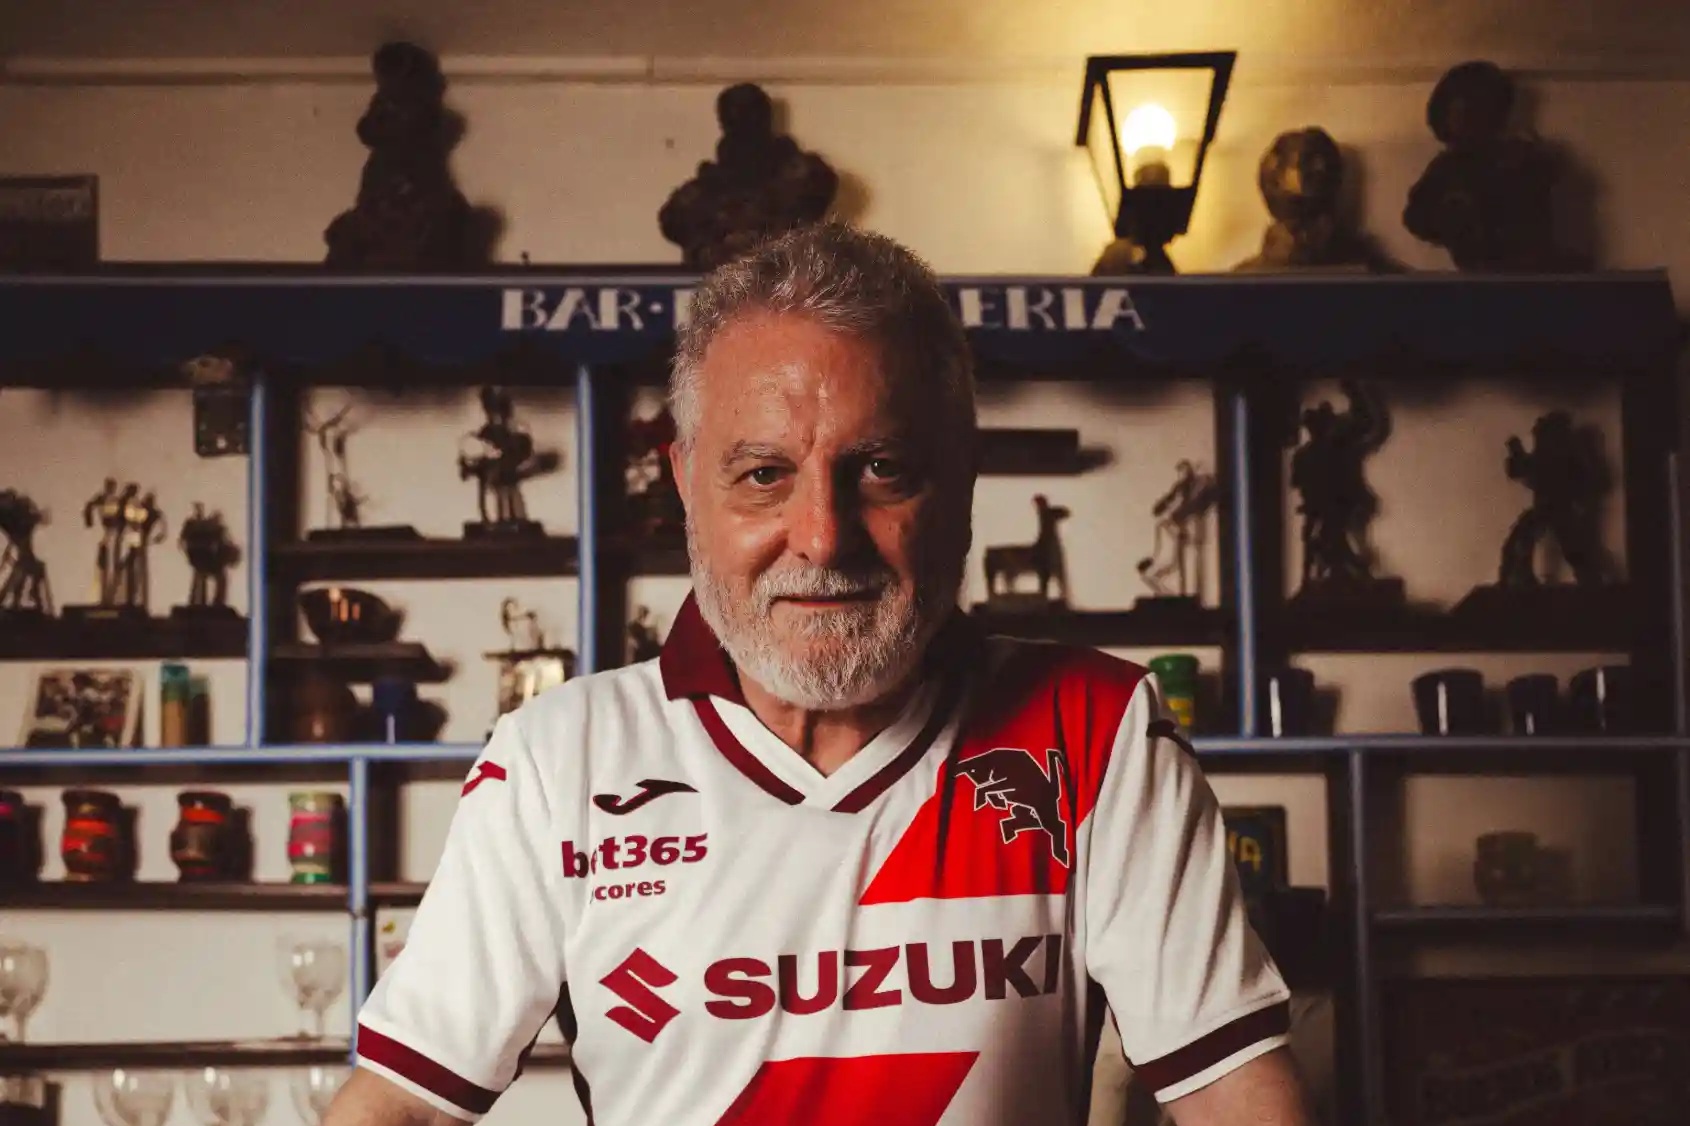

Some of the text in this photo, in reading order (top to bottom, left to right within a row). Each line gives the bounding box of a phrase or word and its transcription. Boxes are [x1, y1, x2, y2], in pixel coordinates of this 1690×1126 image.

[561, 832, 709, 878] bt365
[590, 879, 667, 904] cores
[703, 933, 1062, 1021] SUZUKI
